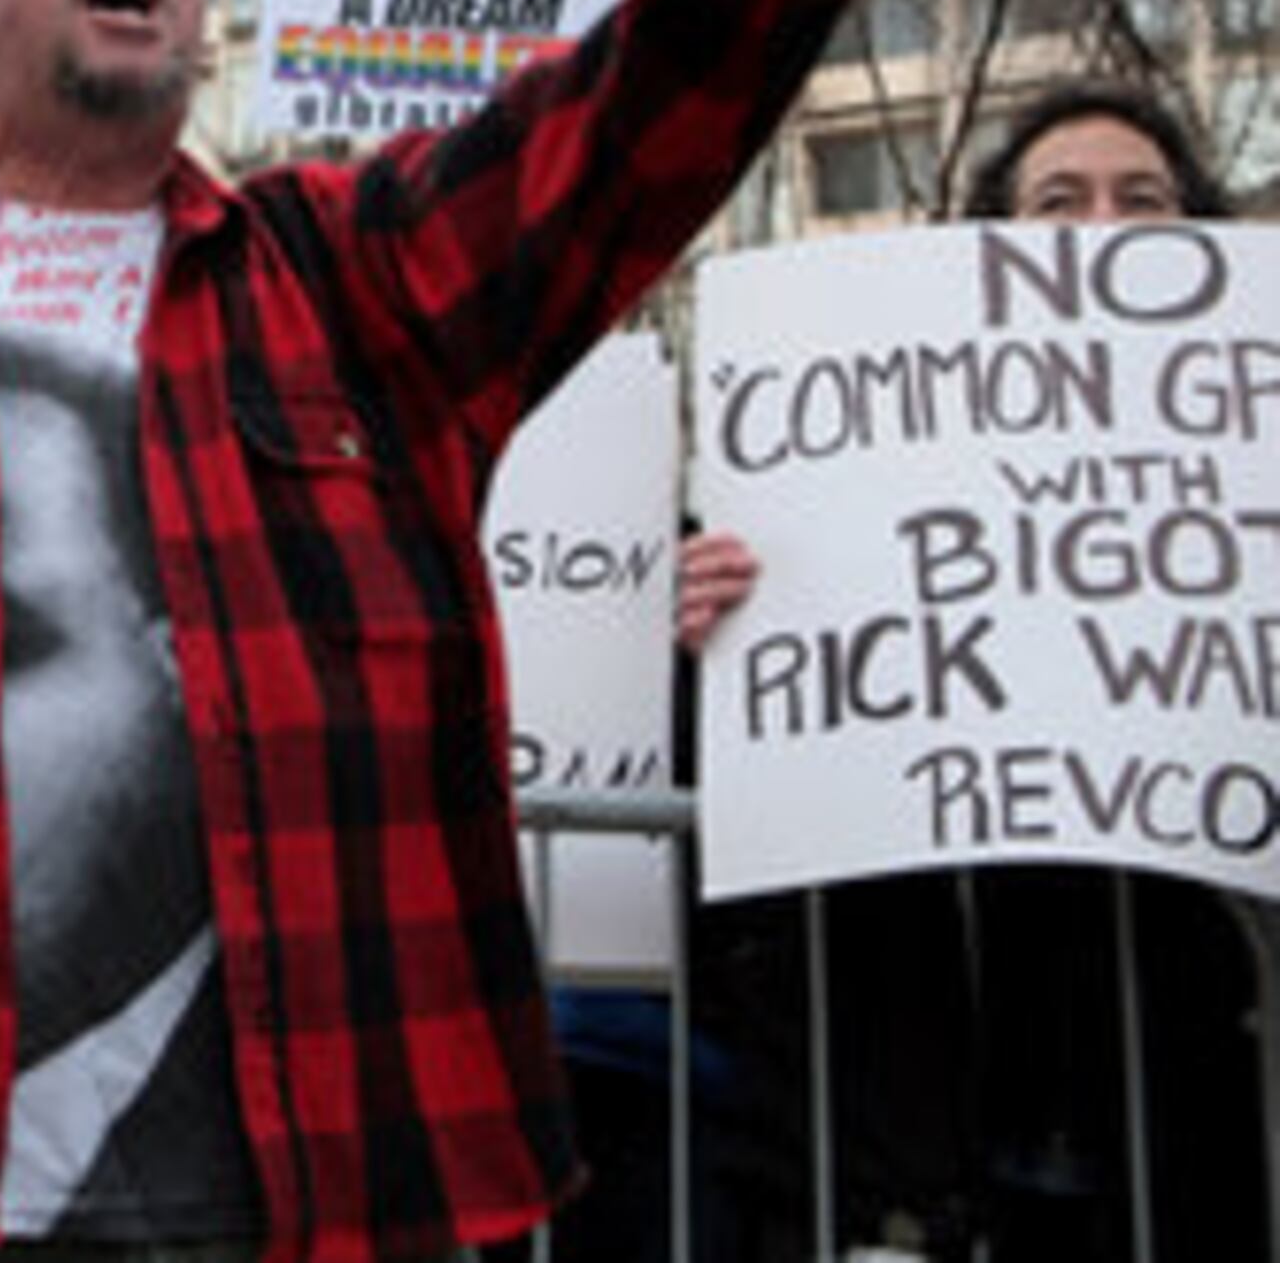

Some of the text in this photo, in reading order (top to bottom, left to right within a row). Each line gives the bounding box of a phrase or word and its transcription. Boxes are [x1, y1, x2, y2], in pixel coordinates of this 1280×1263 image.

[980, 224, 1228, 326] NO
[1000, 454, 1222, 504] WITH
[746, 614, 1008, 738] RICK
